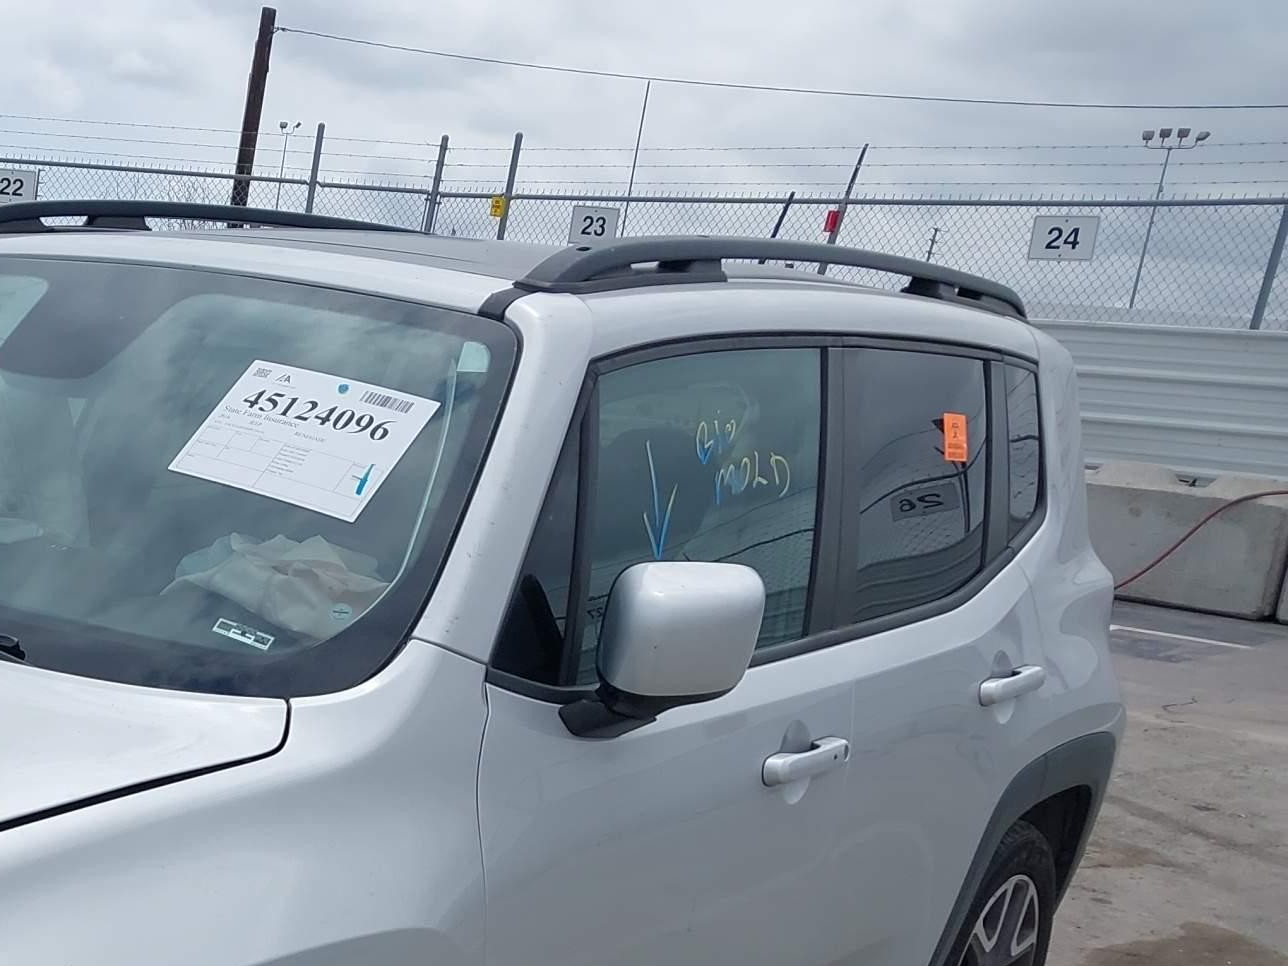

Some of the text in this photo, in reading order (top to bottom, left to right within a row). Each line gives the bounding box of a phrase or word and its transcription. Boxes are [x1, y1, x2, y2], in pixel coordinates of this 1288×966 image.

[0, 177, 24, 197] 22
[581, 215, 606, 237] 23
[1045, 226, 1080, 250] 24
[243, 389, 397, 441] 45124096
